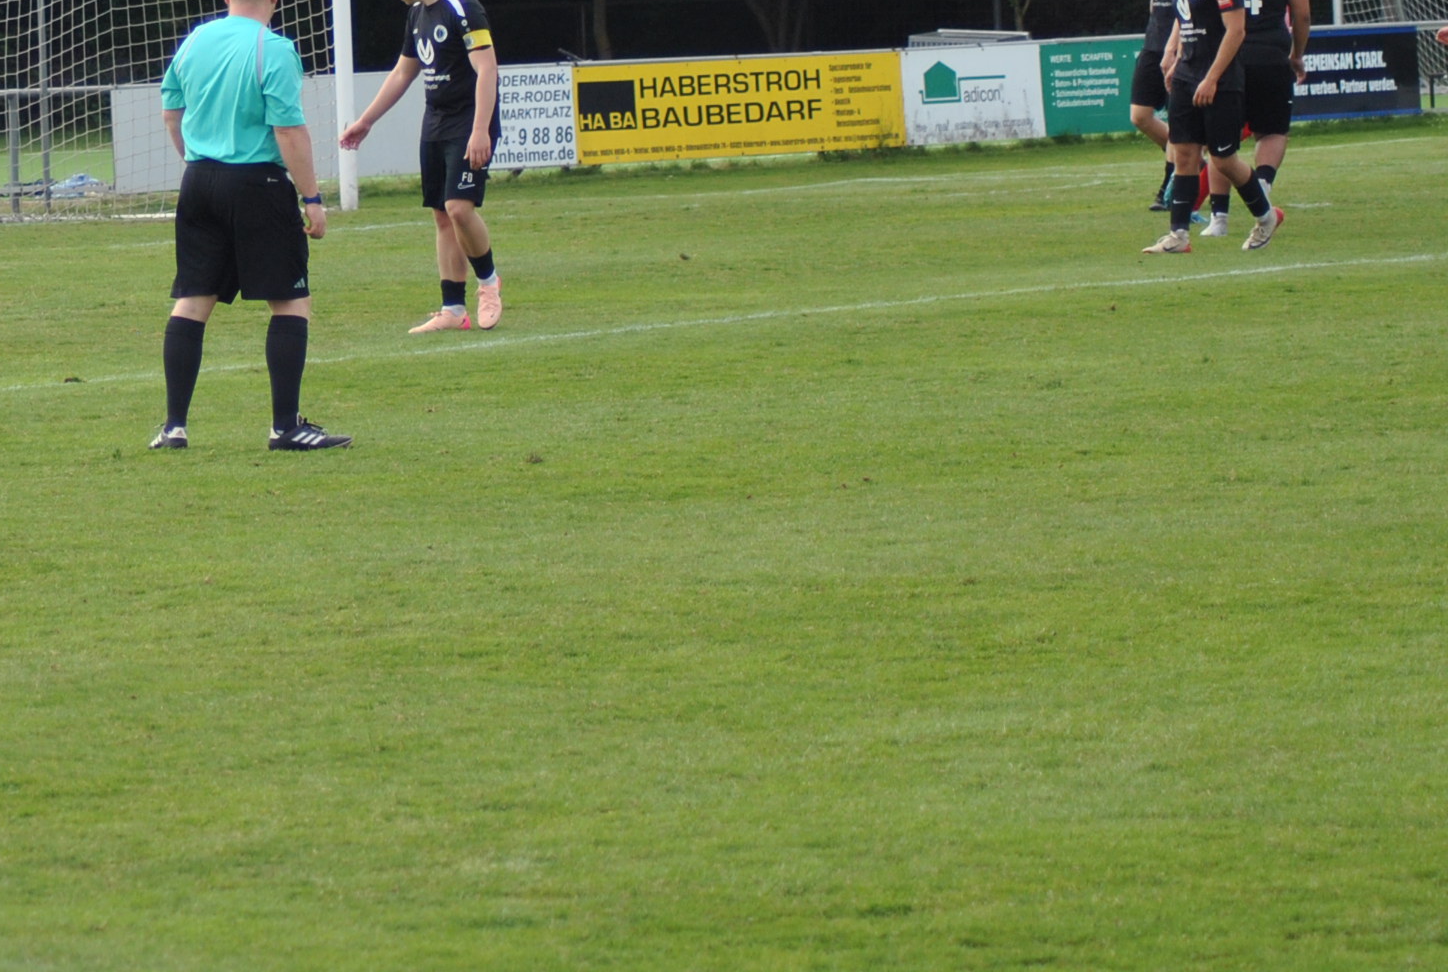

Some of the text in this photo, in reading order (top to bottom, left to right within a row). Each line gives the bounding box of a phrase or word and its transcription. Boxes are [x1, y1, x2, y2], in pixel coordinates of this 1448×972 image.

[1050, 54, 1072, 64] WERTE
[1080, 52, 1113, 62] SCHAFFEN
[1302, 51, 1386, 72] GEMEINSAM STARK.
[639, 69, 821, 99] HABERSTROH
[1340, 79, 1367, 94] Partner
[501, 106, 572, 121] MARKTPLATZ
[580, 111, 636, 130] HA BA
[641, 99, 822, 129] BAUBEDARF
[518, 128, 527, 146] 9
[532, 127, 550, 145] 88
[555, 126, 573, 144] 86
